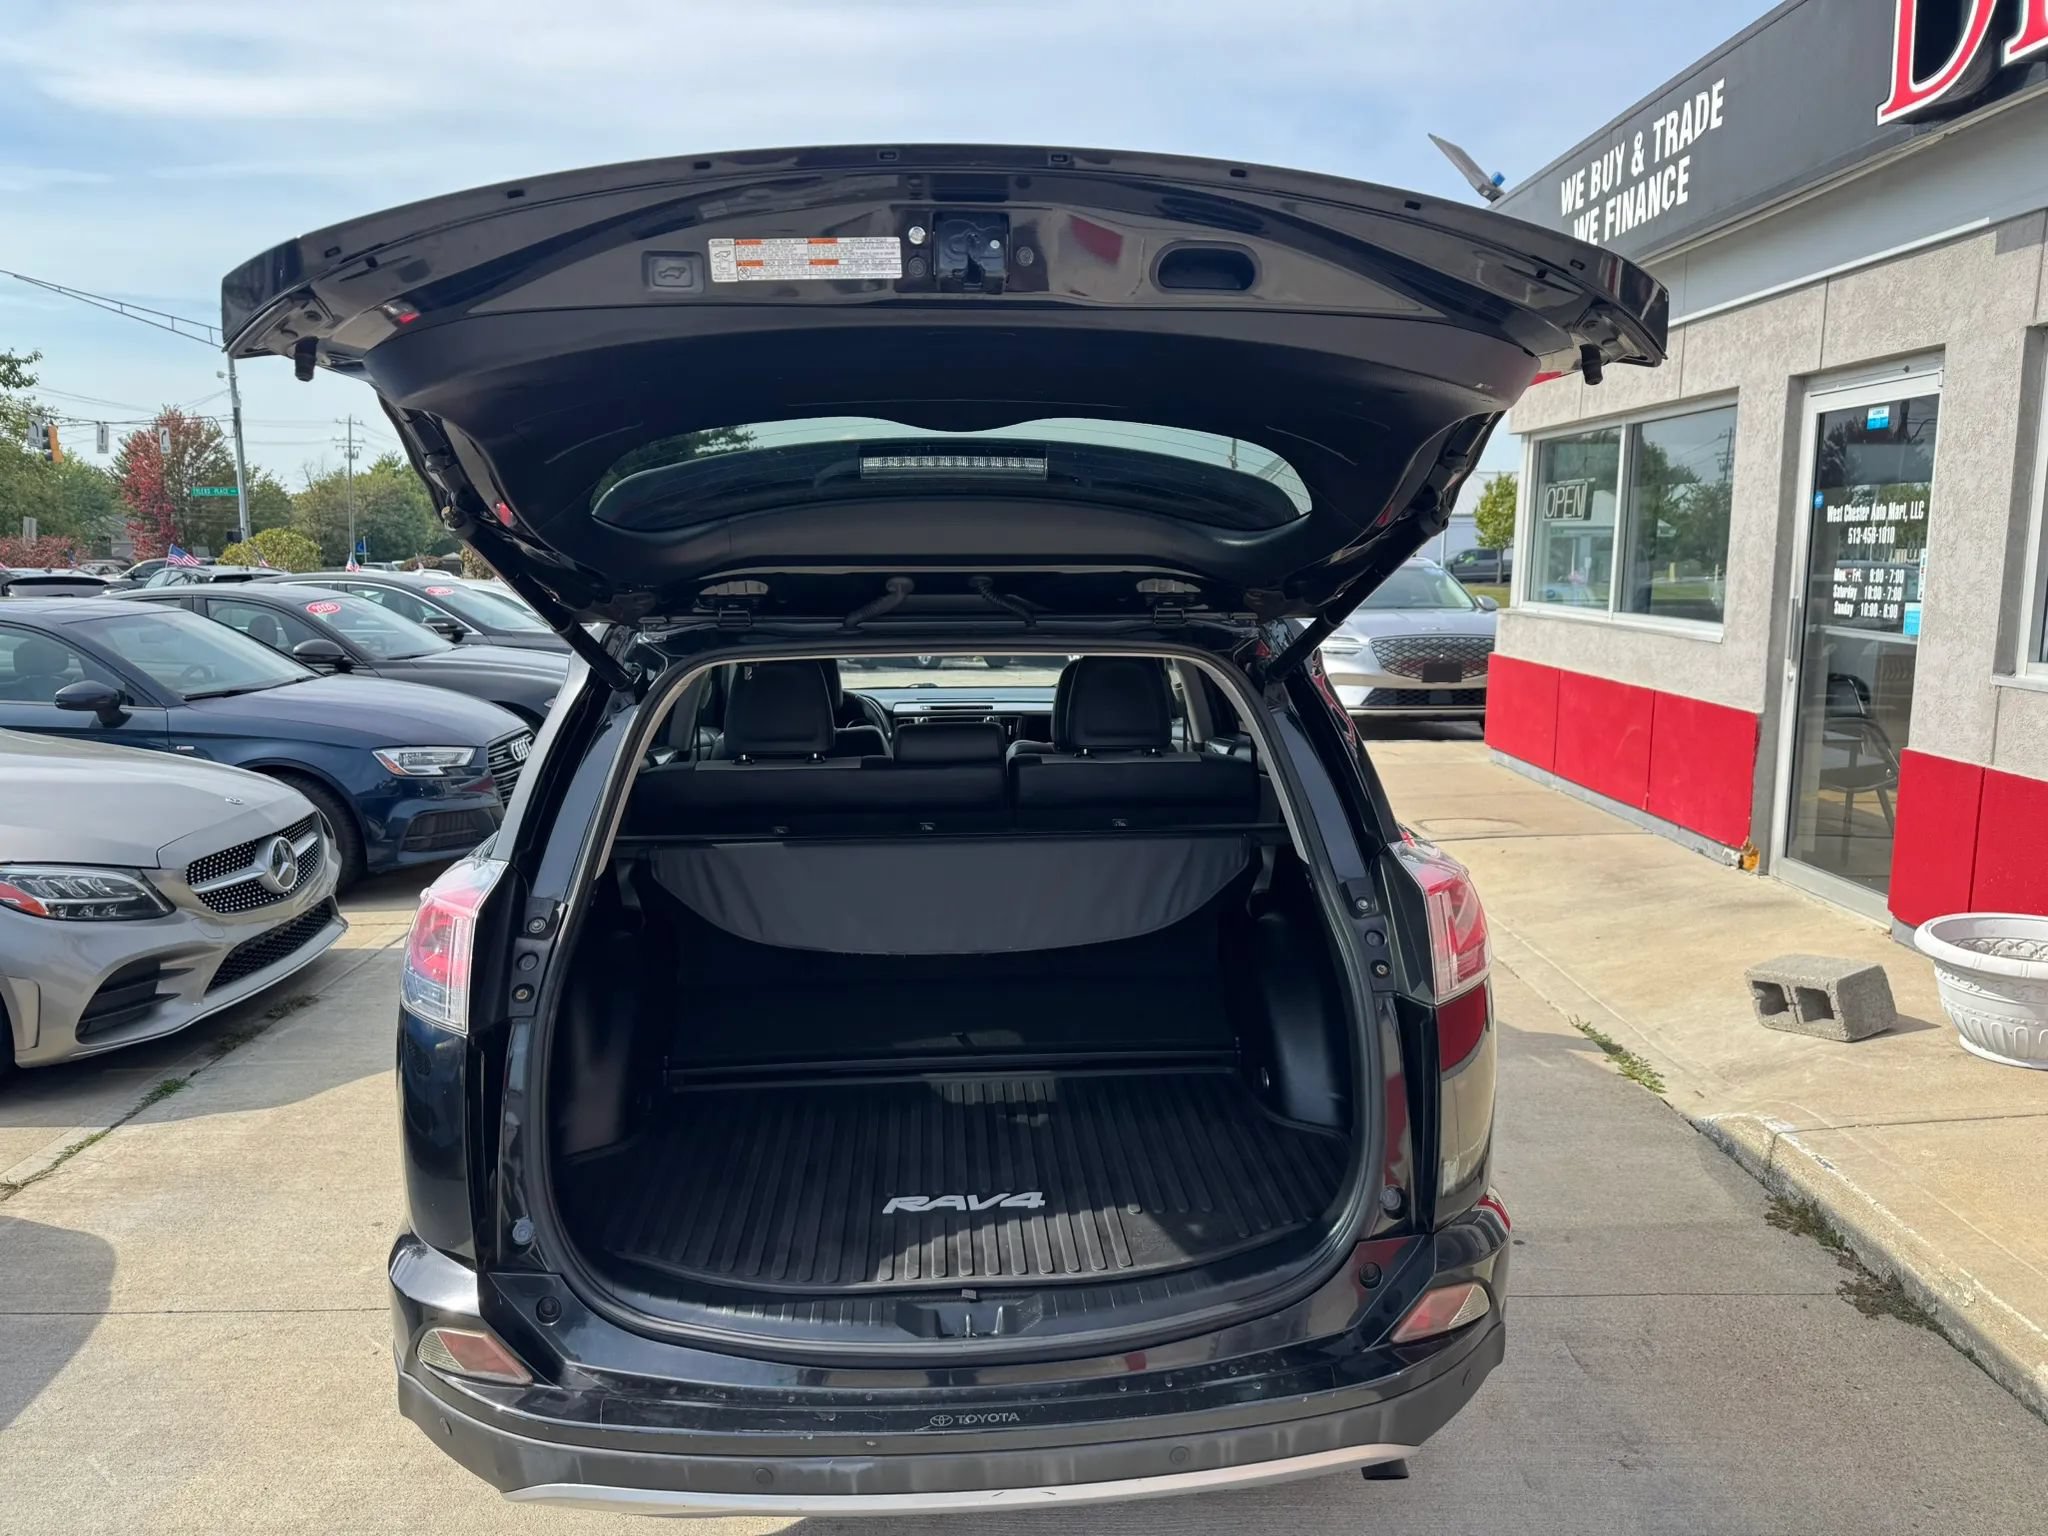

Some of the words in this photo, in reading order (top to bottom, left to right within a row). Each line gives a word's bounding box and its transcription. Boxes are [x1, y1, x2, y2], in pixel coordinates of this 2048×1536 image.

[1561, 167, 1586, 217] WE
[1590, 140, 1625, 201] BUY
[1631, 131, 1645, 177] &
[1653, 77, 1725, 164] TRADE
[1574, 206, 1600, 246] WE
[1604, 155, 1690, 242] FINANCE
[1545, 485, 1585, 518] OPEN
[1827, 505, 1843, 522] West
[1844, 504, 1870, 522] Chester
[1870, 503, 1887, 521] Auto
[1910, 500, 1925, 520] LLC
[1889, 568, 1904, 584] 7:00
[1833, 584, 1857, 601] Saturday
[1864, 585, 1882, 601] 10:00
[1887, 586, 1902, 601] 7:00
[1833, 600, 1854, 618] Sunday
[1861, 602, 1878, 618] 10:00
[882, 1192, 1045, 1214] RAV4
[956, 1412, 1020, 1425] TOYOTA
